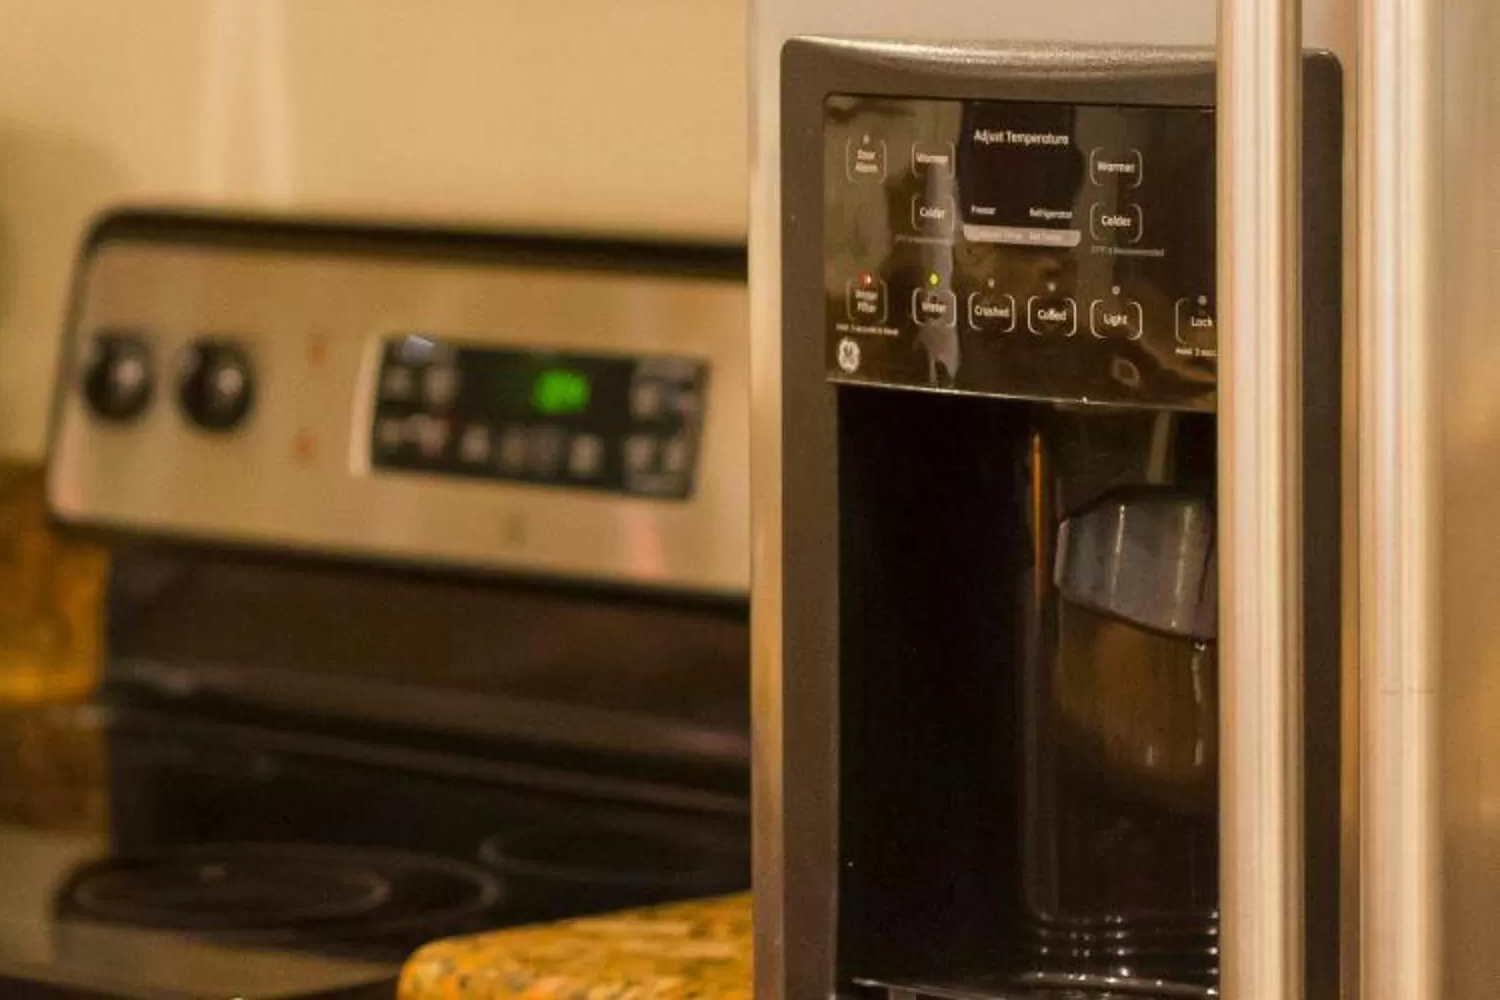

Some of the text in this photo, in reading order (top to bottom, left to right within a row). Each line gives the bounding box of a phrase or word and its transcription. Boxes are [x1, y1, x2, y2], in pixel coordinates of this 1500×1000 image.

[974, 129, 1069, 147] Adjust Temperature
[1101, 215, 1132, 228] Colder
[973, 304, 1010, 318] Crushed
[1103, 313, 1128, 327] Light
[1191, 316, 1213, 328] Lock
